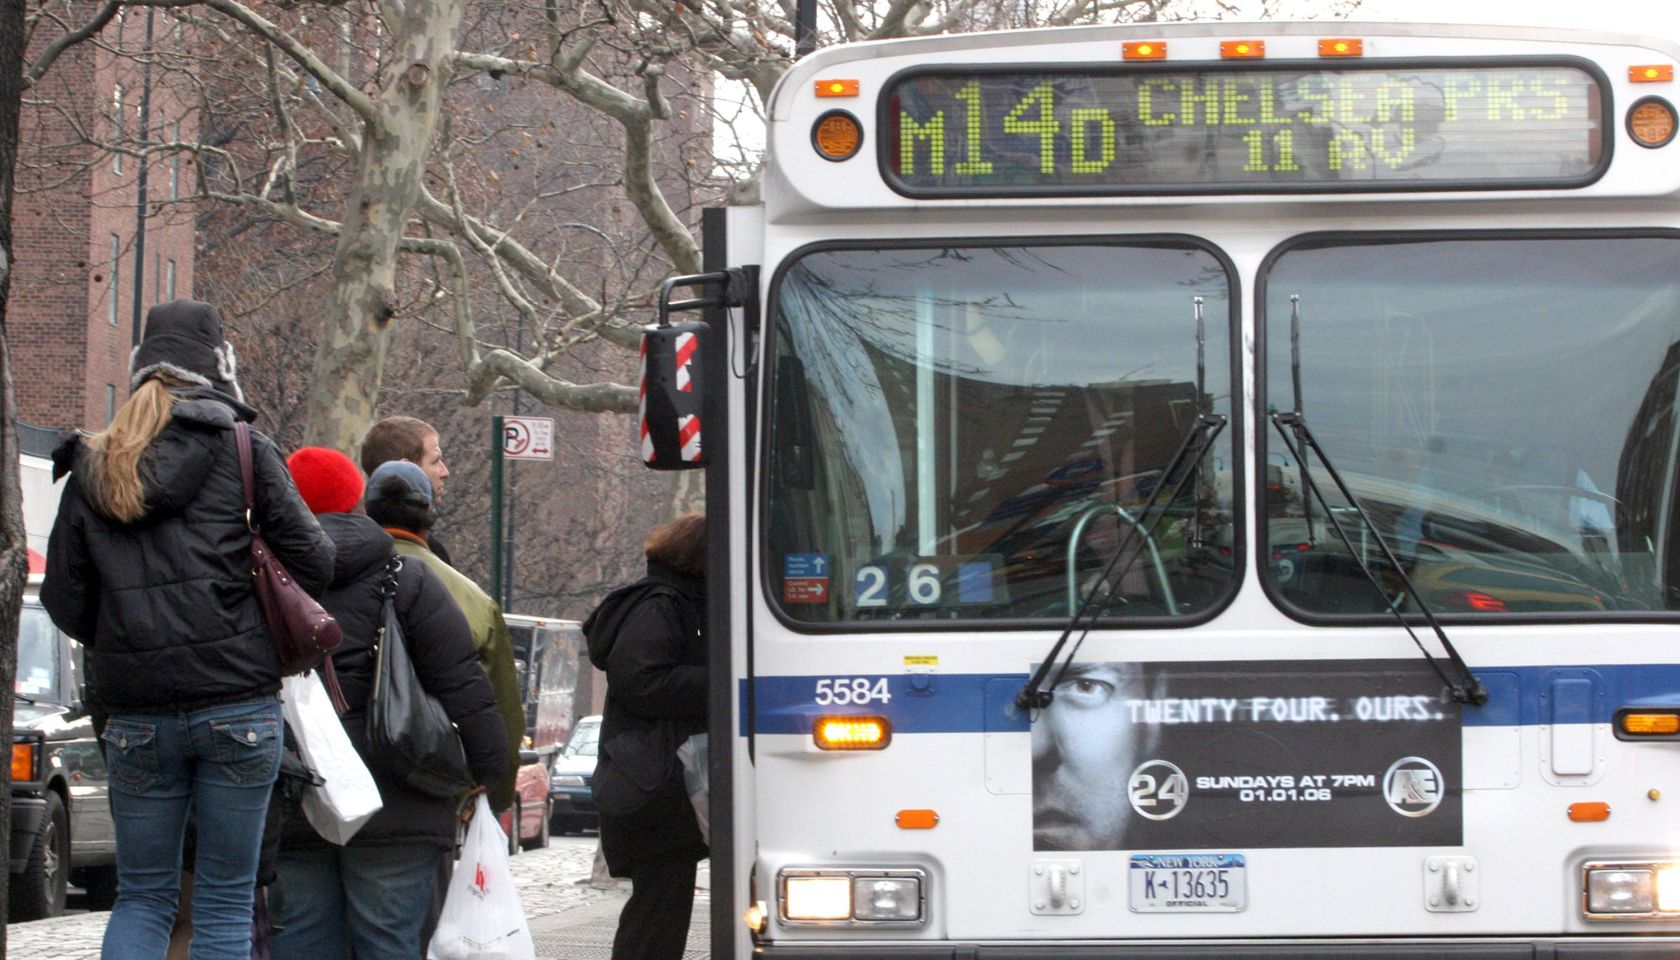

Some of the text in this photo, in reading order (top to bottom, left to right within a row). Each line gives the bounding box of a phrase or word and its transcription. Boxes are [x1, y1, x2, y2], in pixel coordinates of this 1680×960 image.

[1137, 76, 1414, 125] CHELSEA
[1242, 128, 1415, 170] 11 AV
[815, 677, 891, 705] 5584
[1127, 695, 1444, 724] TWENTY FOUR. OURS.
[1132, 773, 1185, 808] 24
[1196, 774, 1376, 789] SUNDAYS AT 7PM
[1239, 788, 1332, 802] 01.01.06
[1156, 855, 1218, 868] NEW YORK
